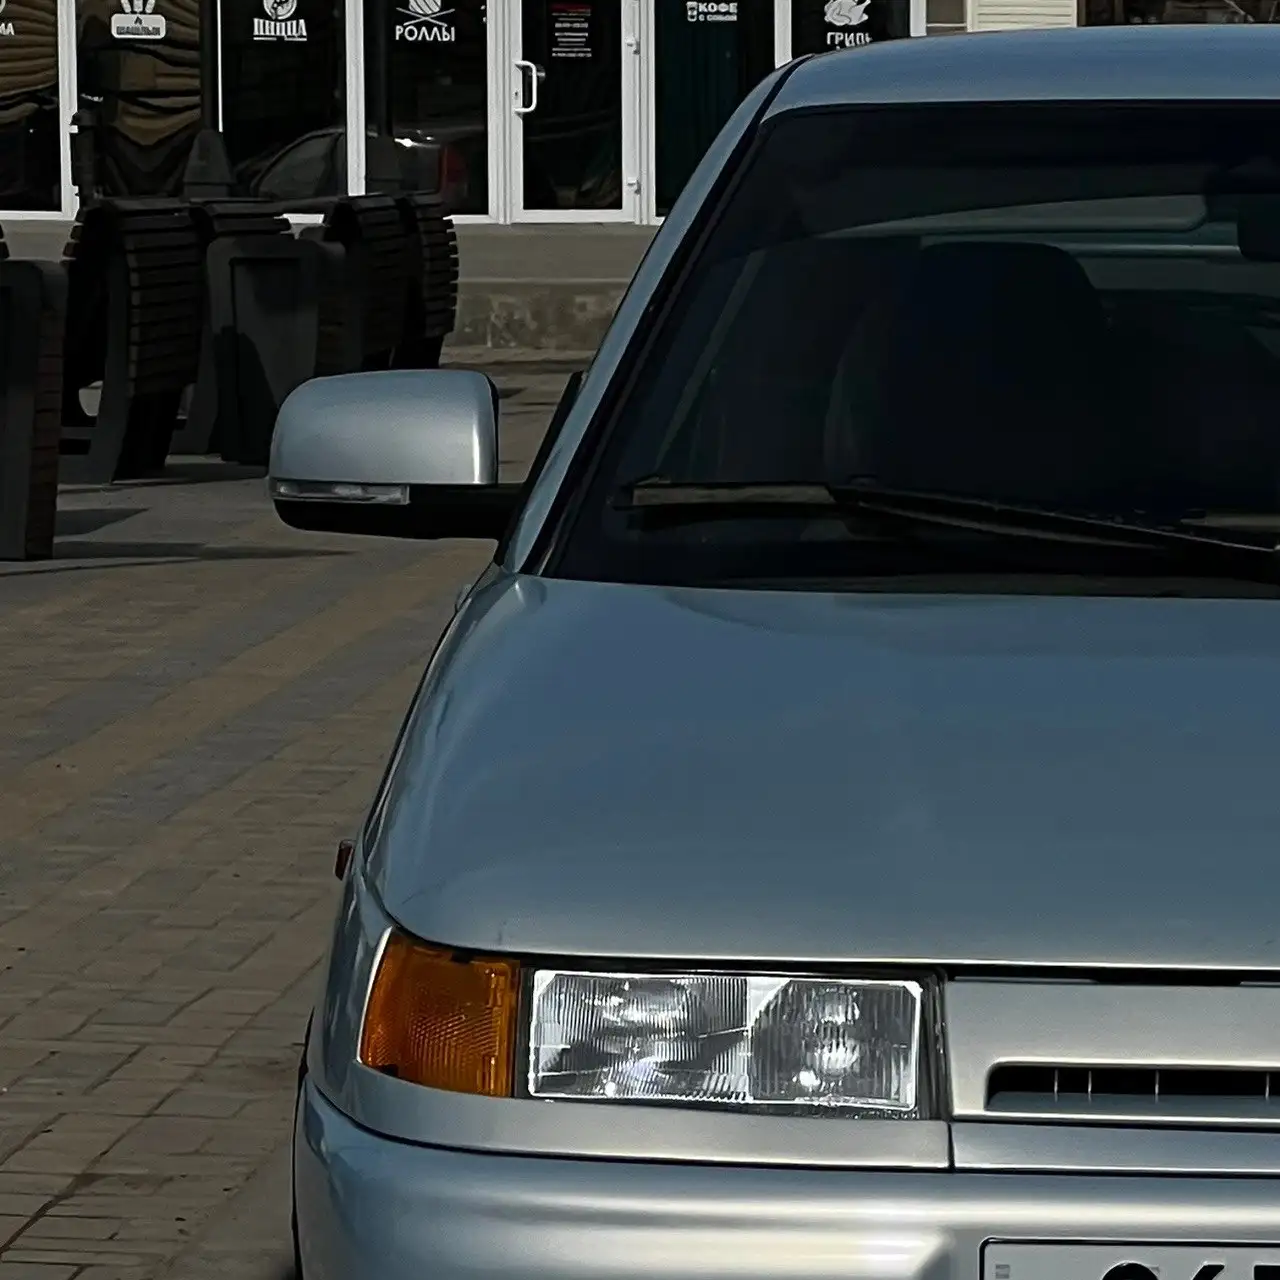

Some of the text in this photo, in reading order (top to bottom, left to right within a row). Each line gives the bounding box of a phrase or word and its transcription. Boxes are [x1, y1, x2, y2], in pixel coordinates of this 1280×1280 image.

[698, 2, 738, 13] КОФЕ
[253, 18, 308, 41] ПИЦЦА
[395, 25, 455, 41] РОЛЛЫ
